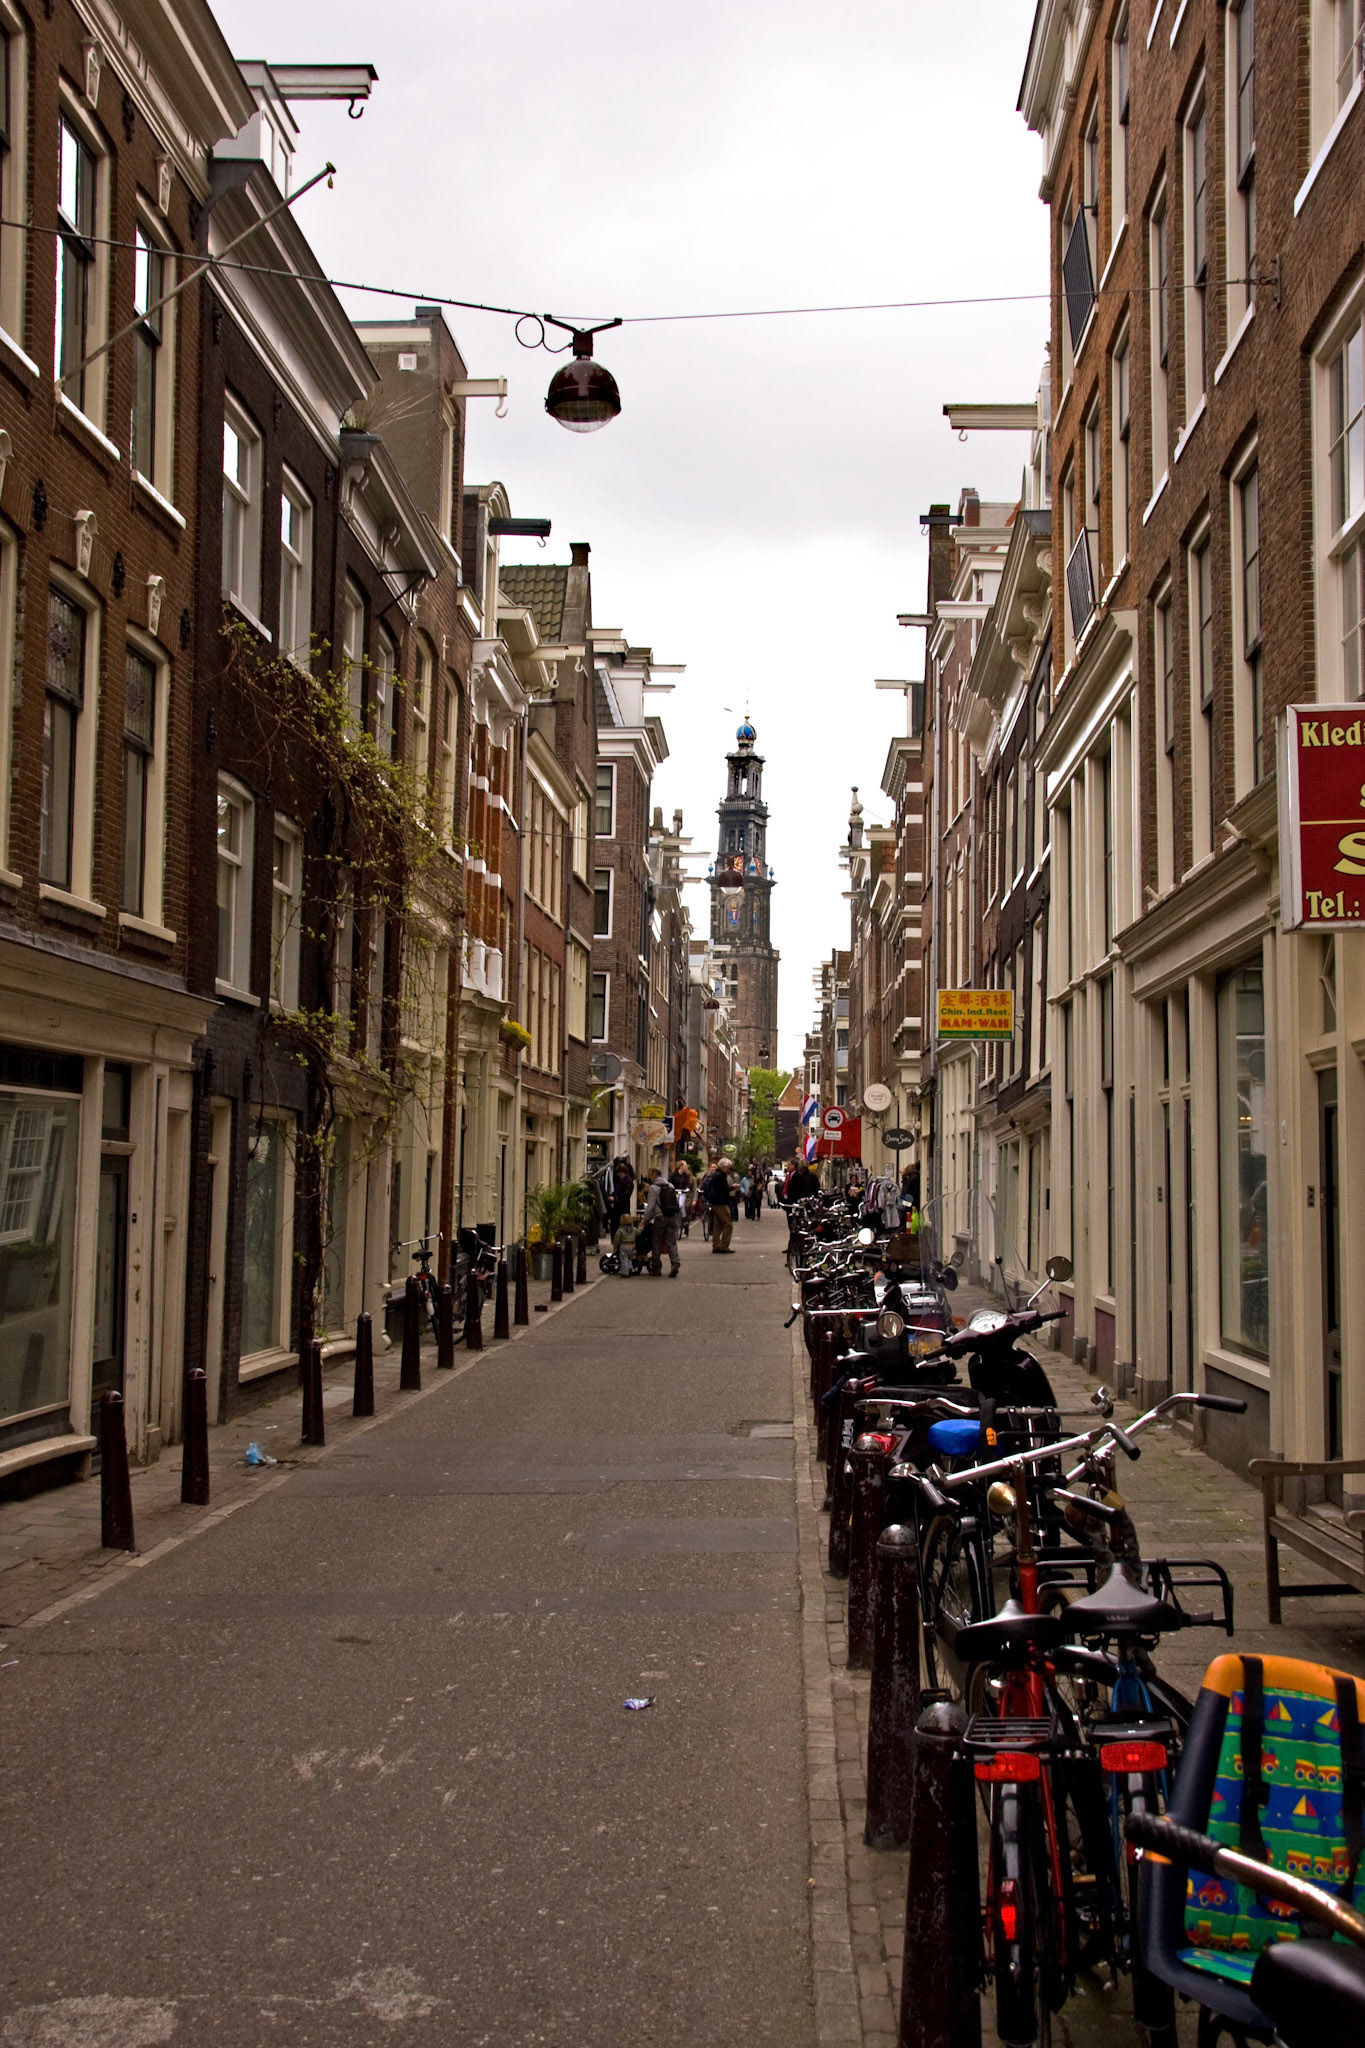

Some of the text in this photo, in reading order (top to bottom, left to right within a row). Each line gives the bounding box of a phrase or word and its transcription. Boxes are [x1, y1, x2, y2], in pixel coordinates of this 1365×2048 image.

[1305, 890, 1360, 918] Tel.:
[941, 1008, 966, 1016] Chin.
[967, 1008, 986, 1016] Ind.
